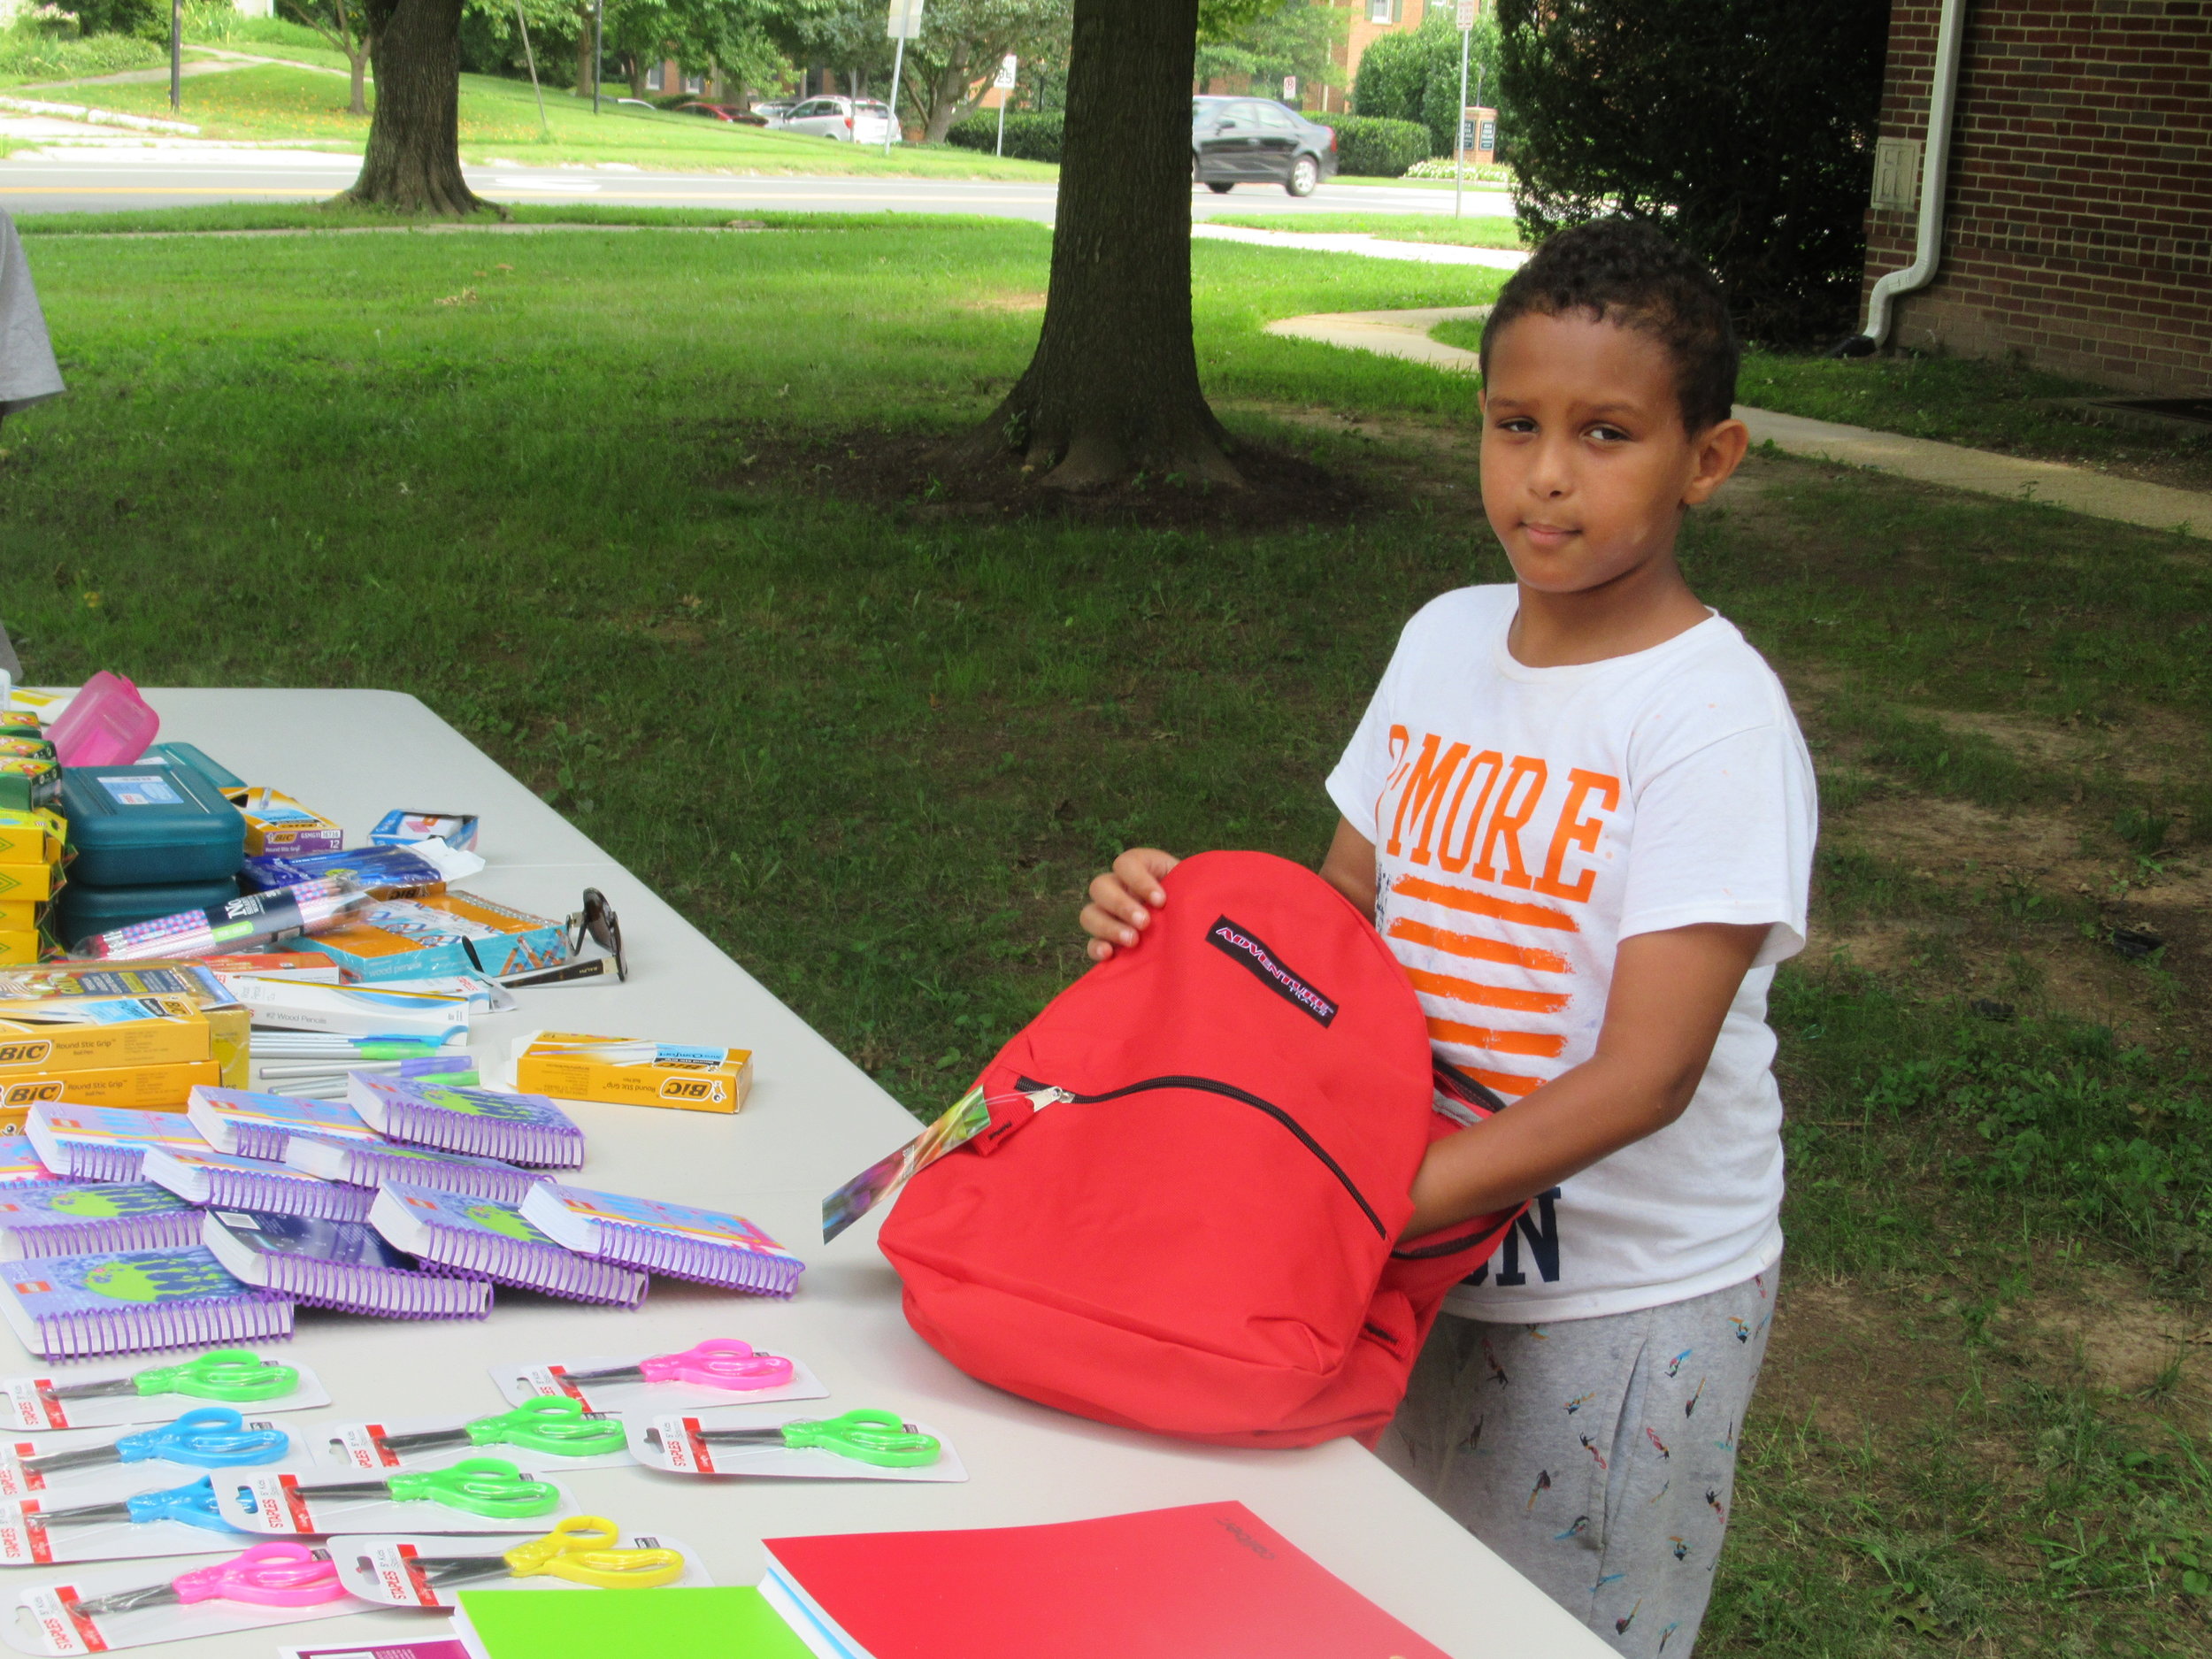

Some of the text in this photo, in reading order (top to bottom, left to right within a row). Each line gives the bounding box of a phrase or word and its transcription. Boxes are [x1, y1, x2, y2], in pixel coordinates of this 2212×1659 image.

[330, 840, 340, 849] 12
[277, 1012, 300, 1022] Wood
[301, 1014, 327, 1025] Pencils
[68, 1082, 92, 1091] Round
[621, 1083, 634, 1092] Stic
[634, 1084, 656, 1093] Round
[19, 1402, 40, 1425] STAPLES
[667, 1440, 687, 1466] STAPLES
[262, 1499, 284, 1528] STAPLES
[1, 1528, 20, 1557] STAPLES
[382, 1571, 407, 1600] STAPLES
[43, 1617, 73, 1649] STAPLES
